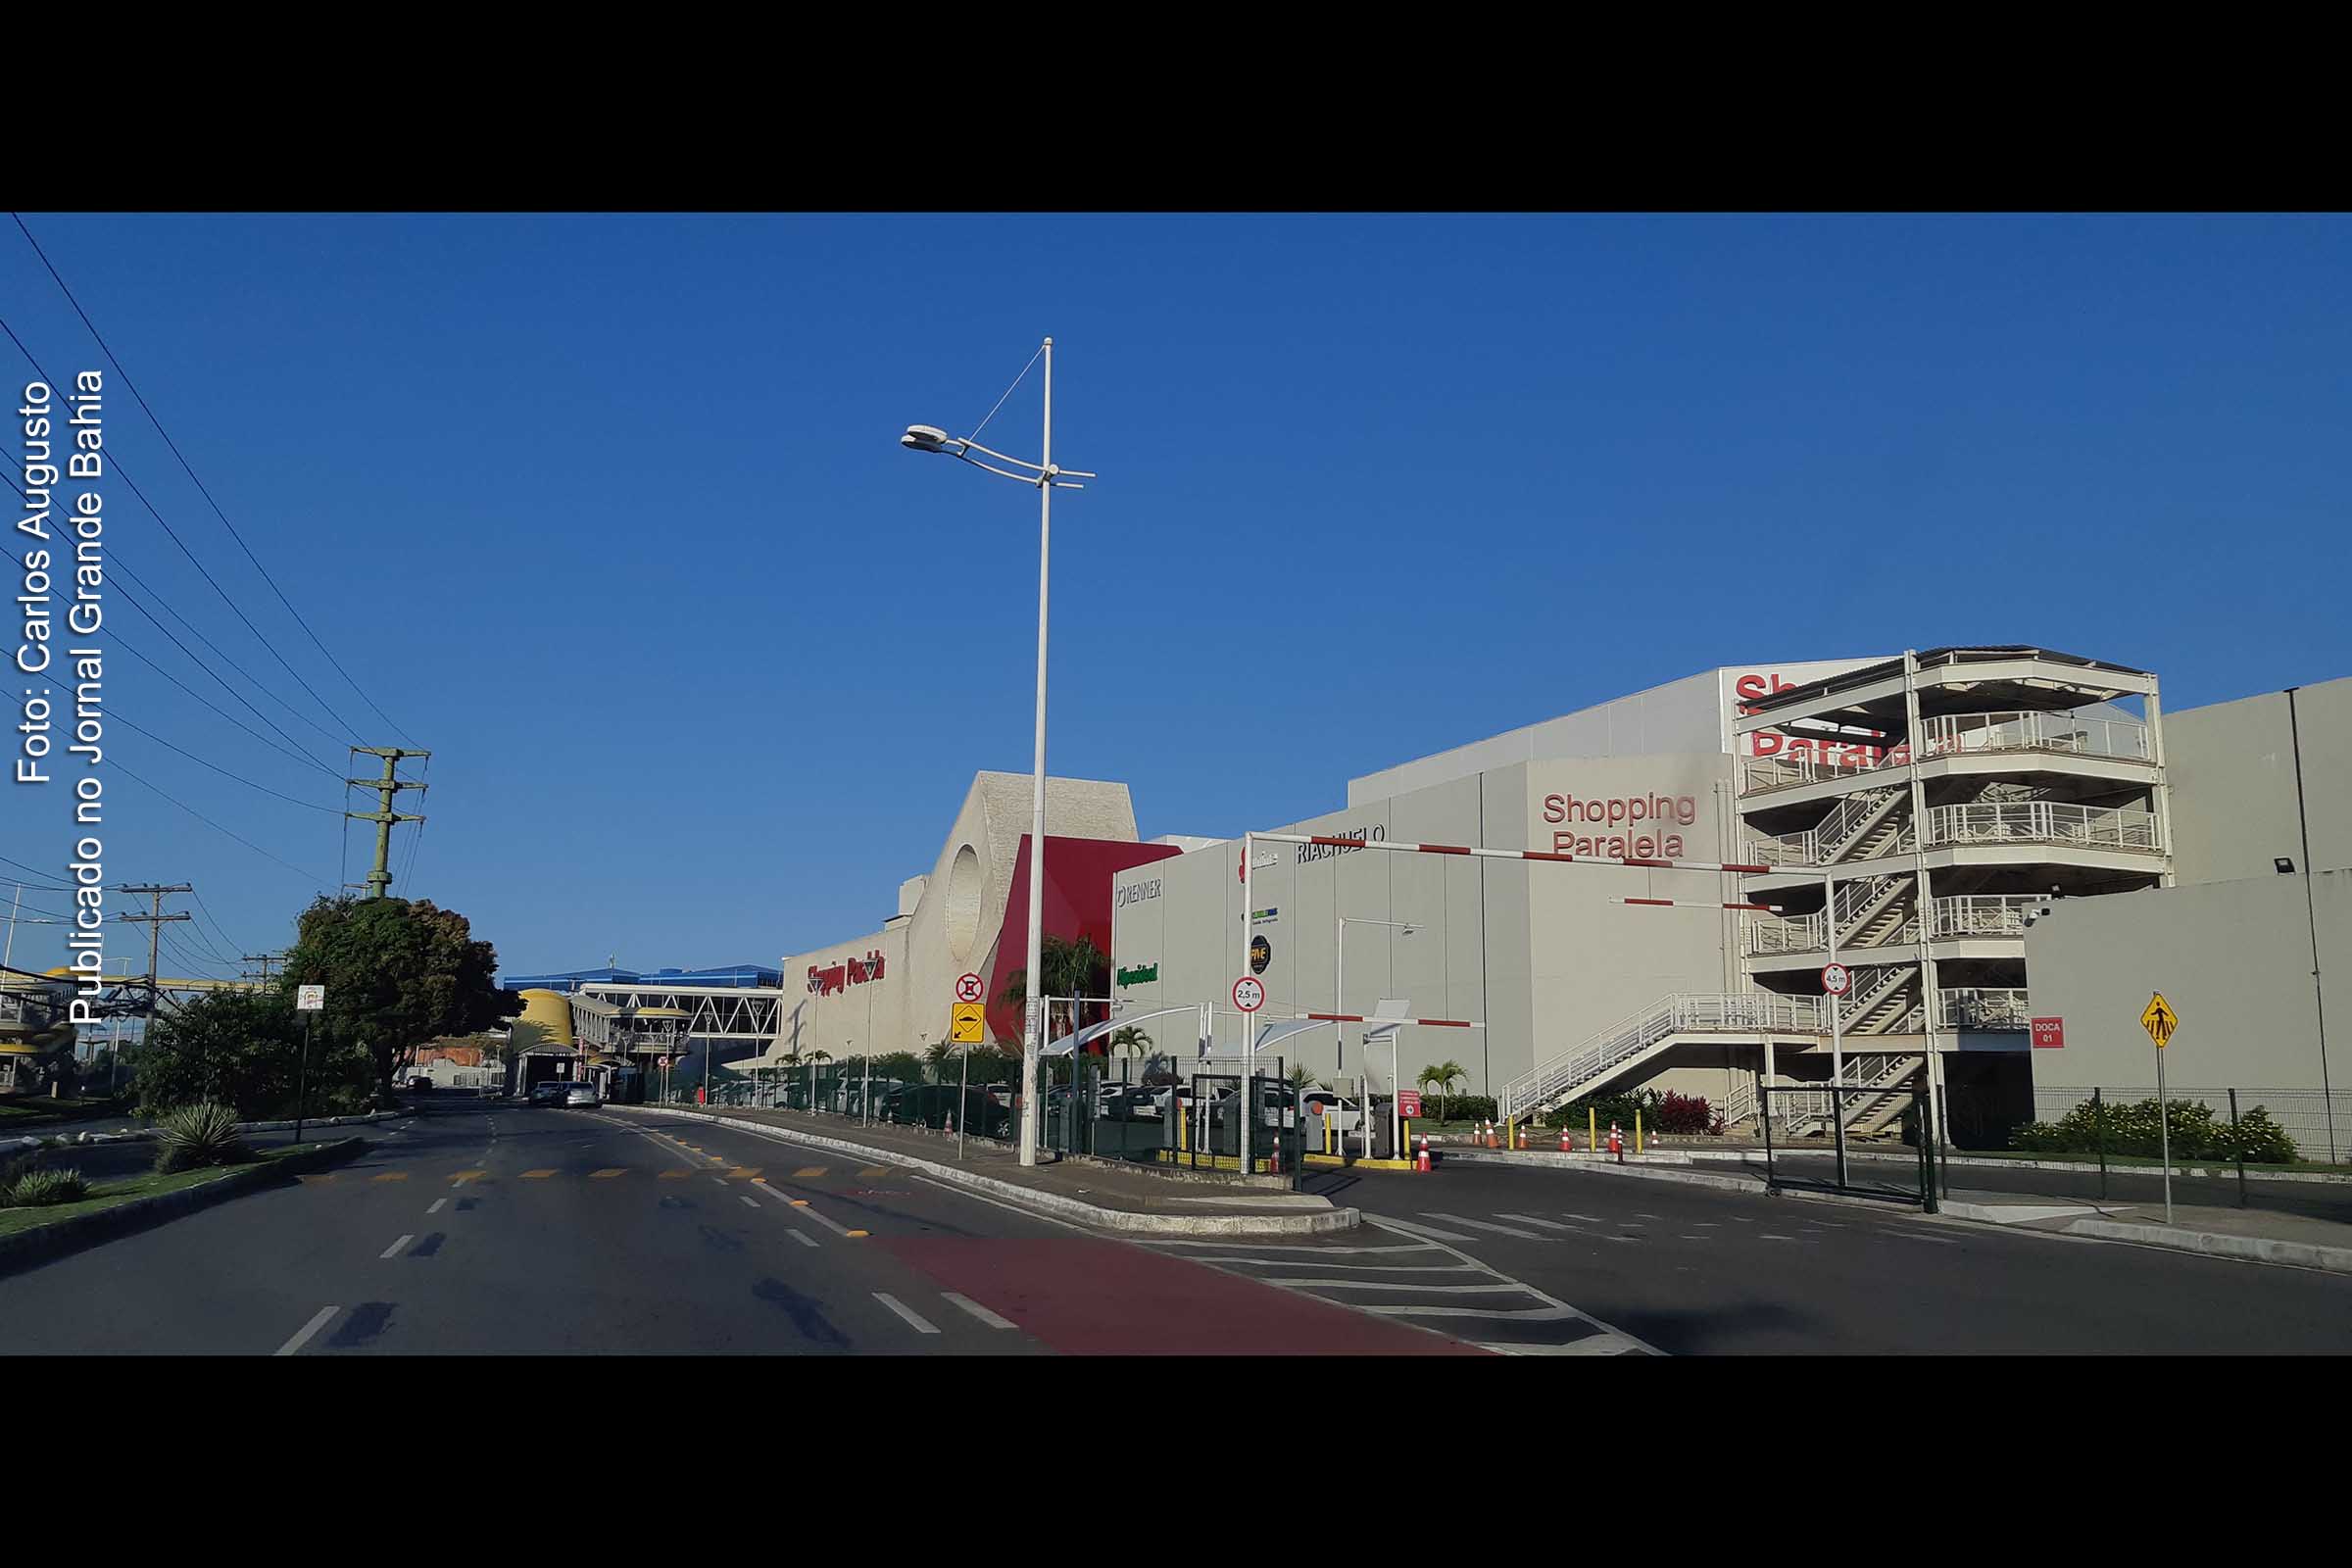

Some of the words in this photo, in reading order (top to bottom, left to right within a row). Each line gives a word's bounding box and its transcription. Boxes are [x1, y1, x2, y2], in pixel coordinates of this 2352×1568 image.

[1543, 792, 1696, 828] Shopping
[1553, 829, 1684, 858] Paralela
[1238, 990, 1250, 999] 2,5
[2034, 1023, 2061, 1032] DOCA
[2042, 1034, 2053, 1043] 01
